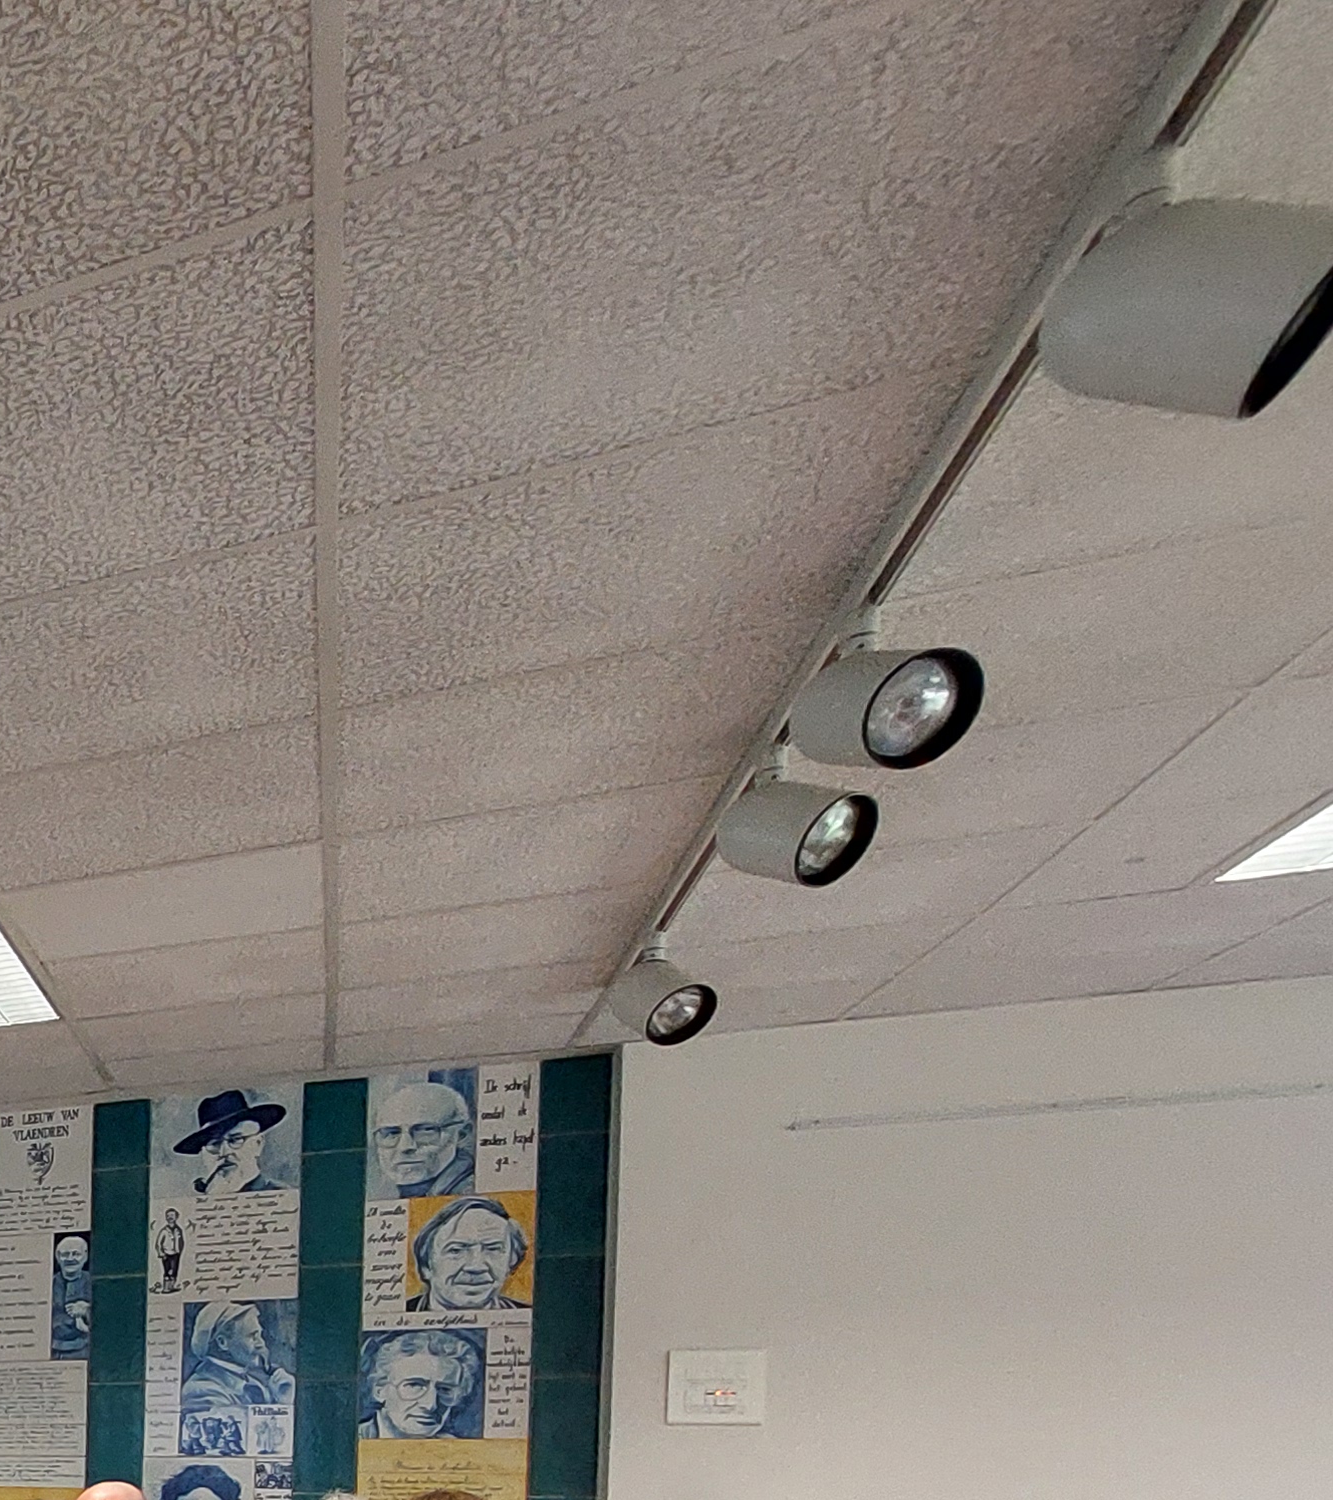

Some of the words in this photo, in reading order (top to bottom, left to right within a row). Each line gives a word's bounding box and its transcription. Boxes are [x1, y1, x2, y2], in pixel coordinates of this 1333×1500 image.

[0, 1116, 14, 1128] DE
[22, 1112, 54, 1125] LEEUW
[61, 1109, 79, 1121] VAN
